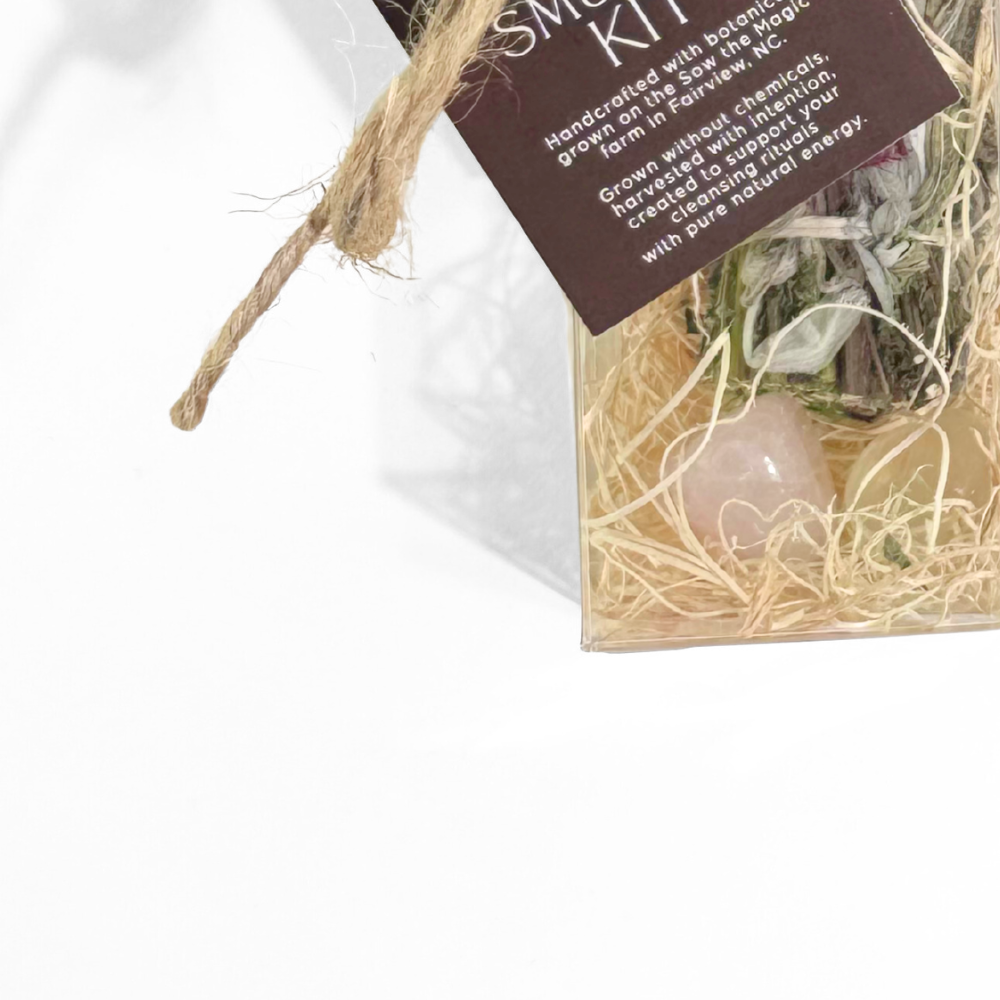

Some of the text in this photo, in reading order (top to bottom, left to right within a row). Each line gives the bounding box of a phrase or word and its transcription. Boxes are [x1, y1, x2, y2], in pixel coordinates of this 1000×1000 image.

[544, 68, 660, 151] Handcrafted
[662, 44, 703, 73] with
[558, 123, 616, 167] grown
[619, 105, 643, 125] on
[643, 83, 676, 107] the
[678, 55, 717, 86] Sow
[719, 34, 752, 58] the
[599, 53, 829, 203] Grown without chemicals,
[600, 33, 788, 159] farm in Fairview, NC.
[611, 71, 837, 218] harvested with intention,
[628, 86, 839, 229] created to support your
[641, 114, 868, 263] with pure natural energy.
[671, 121, 819, 223] cleansing rituals
